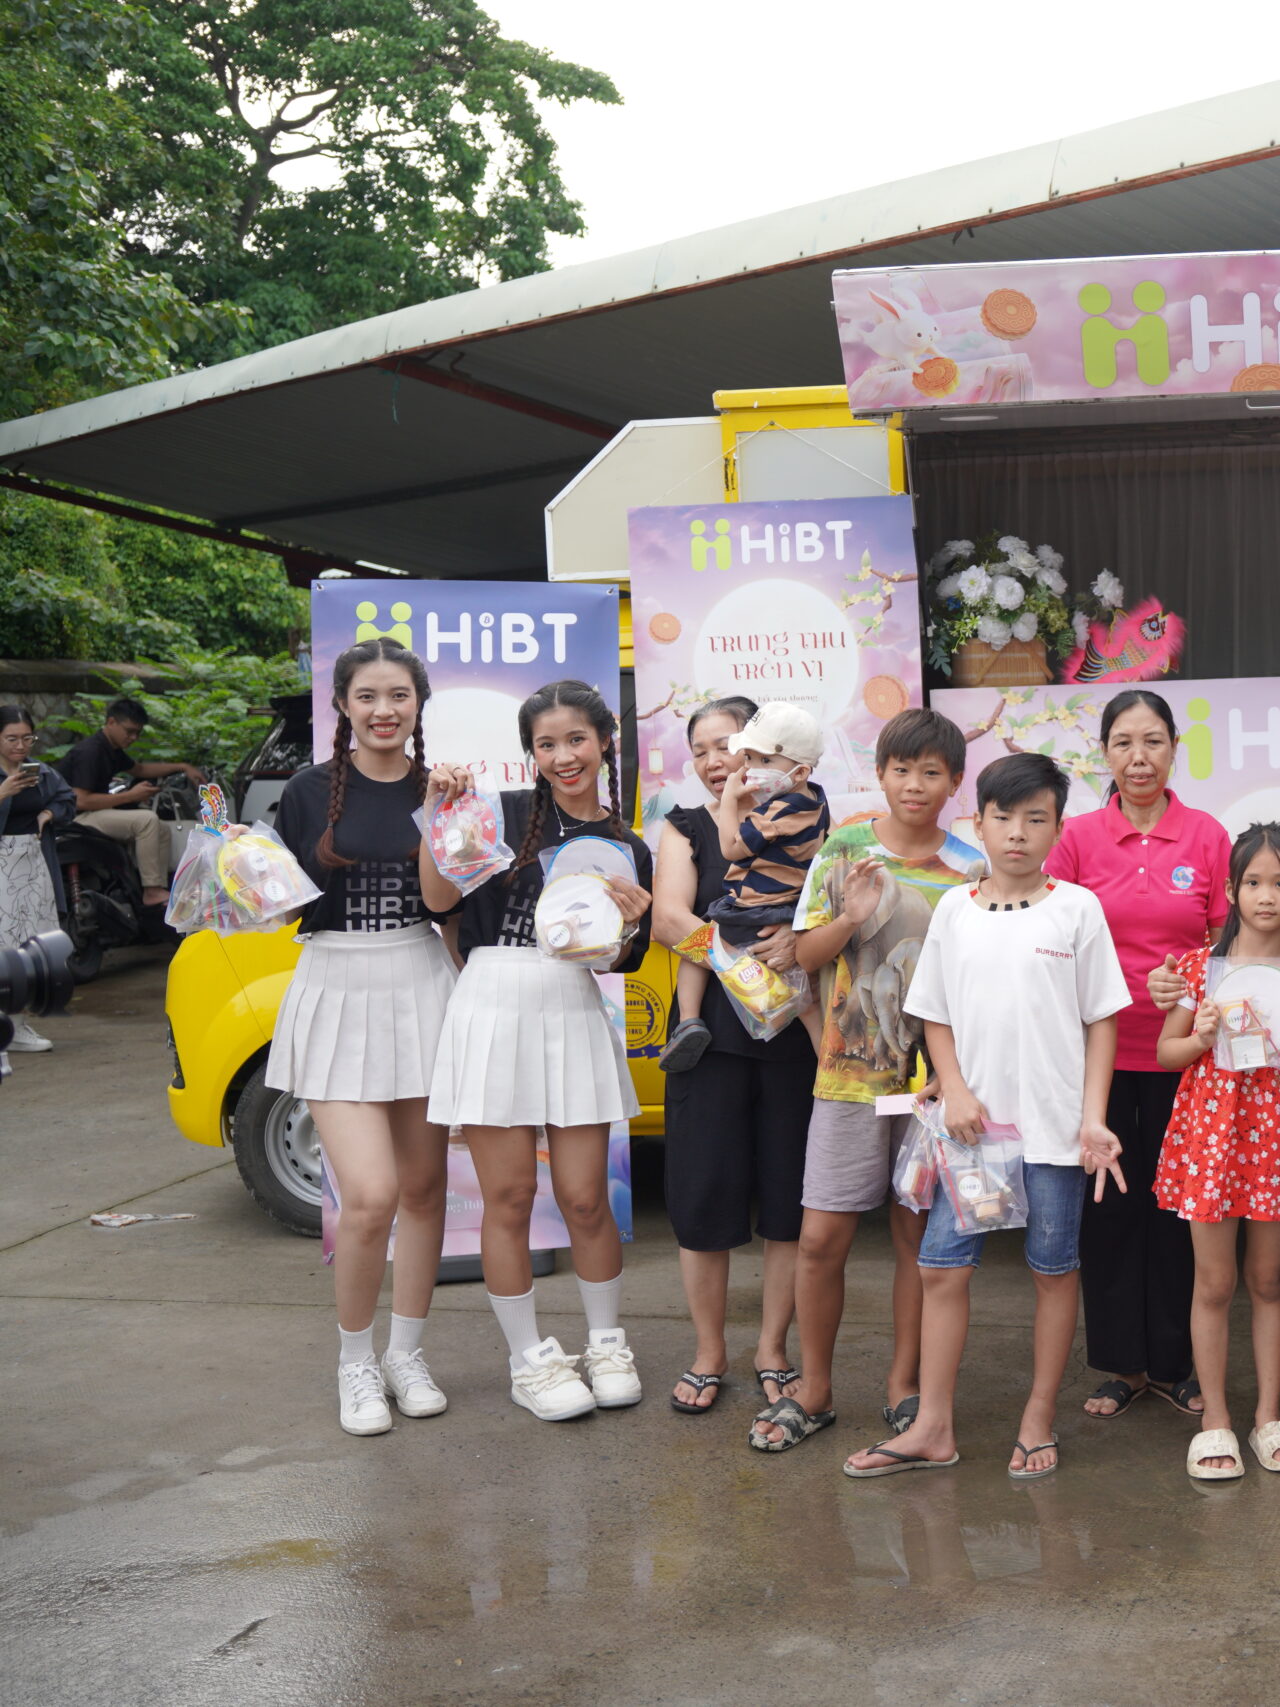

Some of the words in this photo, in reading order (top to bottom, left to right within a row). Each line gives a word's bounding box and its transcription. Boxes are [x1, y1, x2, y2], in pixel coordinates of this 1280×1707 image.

[741, 520, 853, 565] HiBT
[426, 611, 578, 664] HiBT
[1035, 947, 1074, 960] BURBERRY
